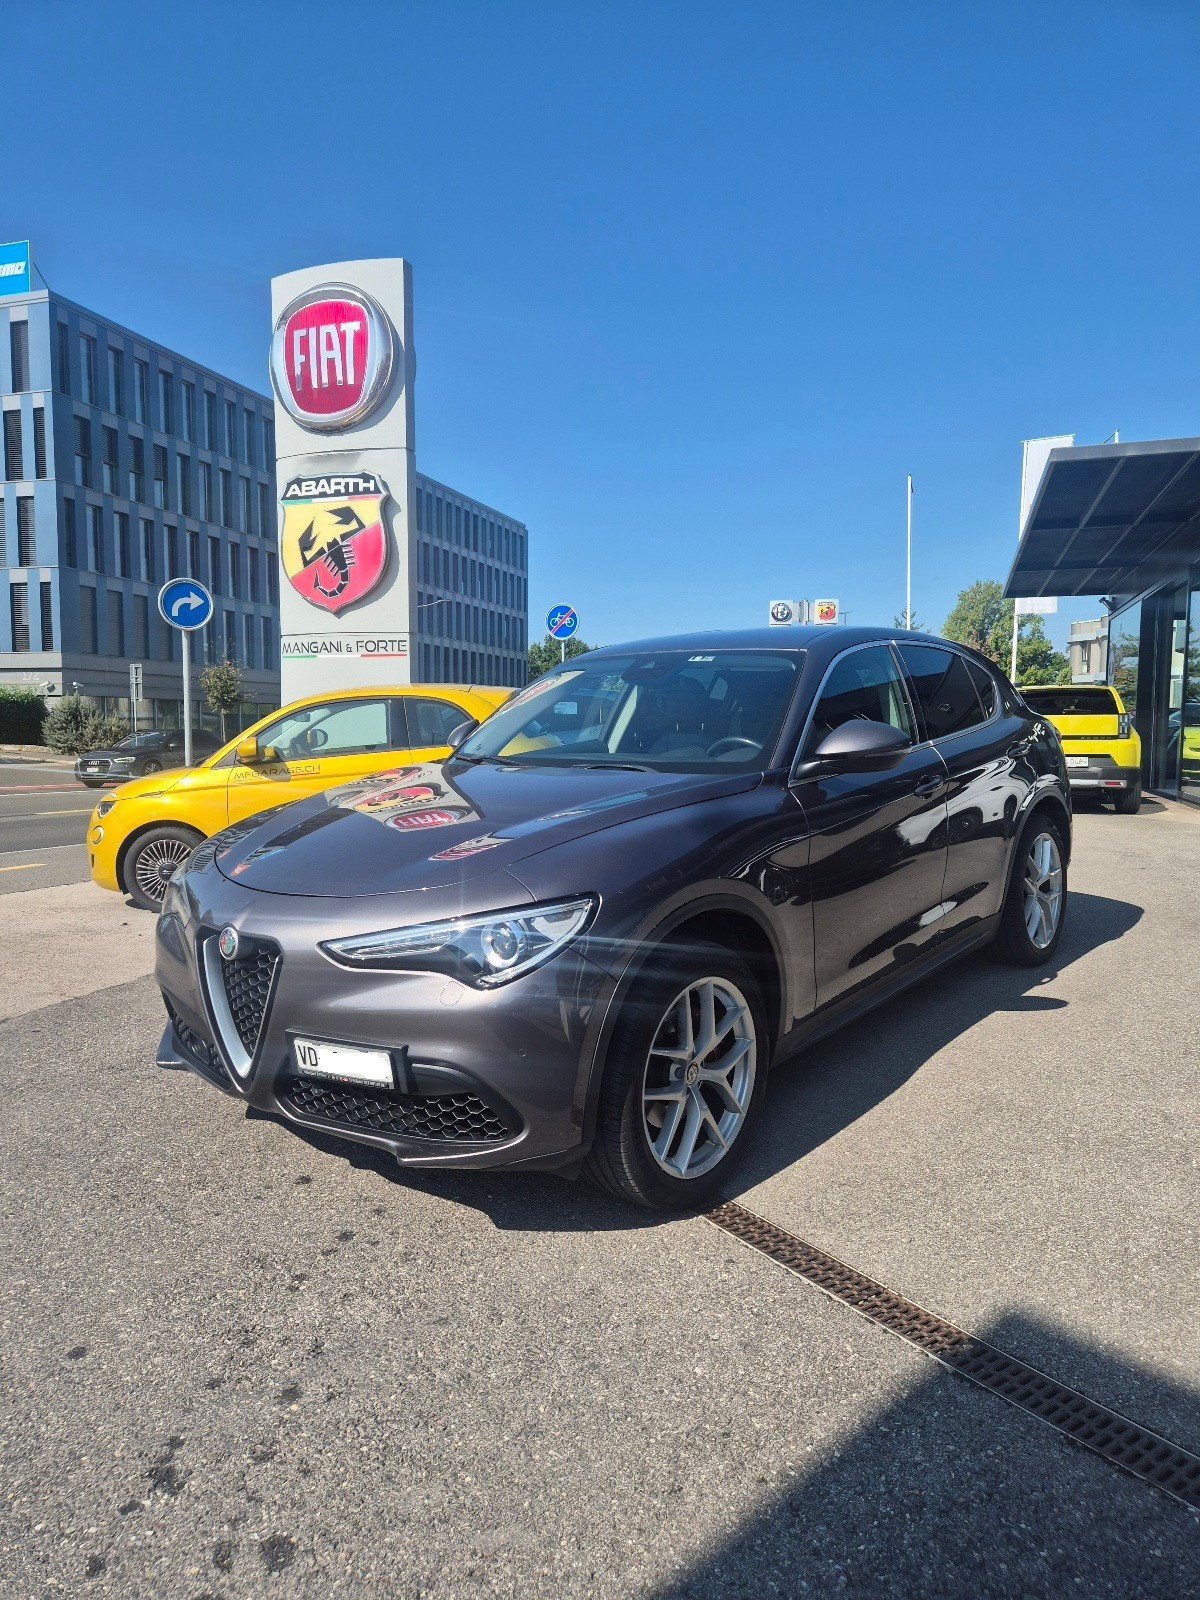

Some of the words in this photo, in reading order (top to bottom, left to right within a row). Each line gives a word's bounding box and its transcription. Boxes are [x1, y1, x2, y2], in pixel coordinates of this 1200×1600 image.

[293, 321, 361, 391] FIAT
[286, 477, 375, 498] ABARTH
[282, 641, 342, 654] MANGANI
[345, 643, 353, 653] &
[356, 639, 408, 653] FORTE
[234, 764, 321, 779] MFGARAGE.CH
[297, 1044, 319, 1067] VD
